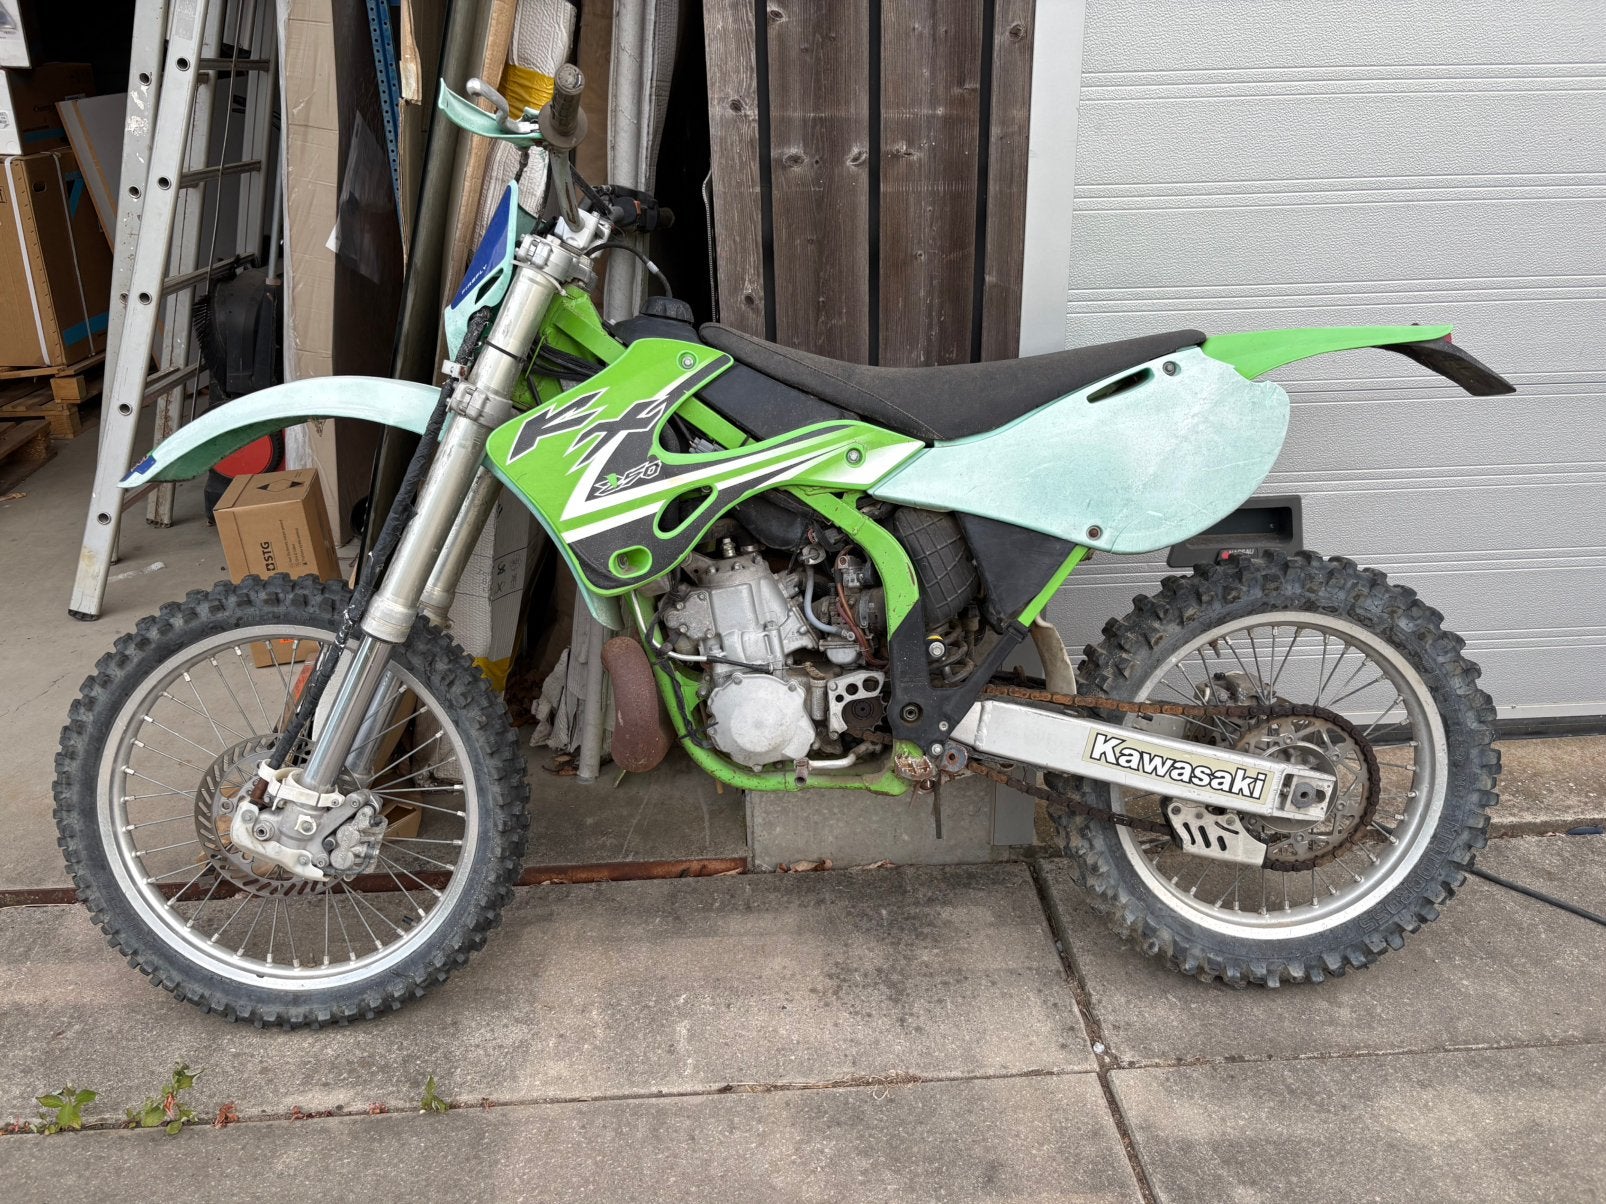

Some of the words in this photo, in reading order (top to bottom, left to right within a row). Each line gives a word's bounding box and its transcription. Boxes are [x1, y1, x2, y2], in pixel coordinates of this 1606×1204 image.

[461, 264, 488, 295] FIREFLY
[506, 387, 669, 476] KX
[260, 541, 274, 562] STG
[1089, 733, 1267, 800] Kawasaki
